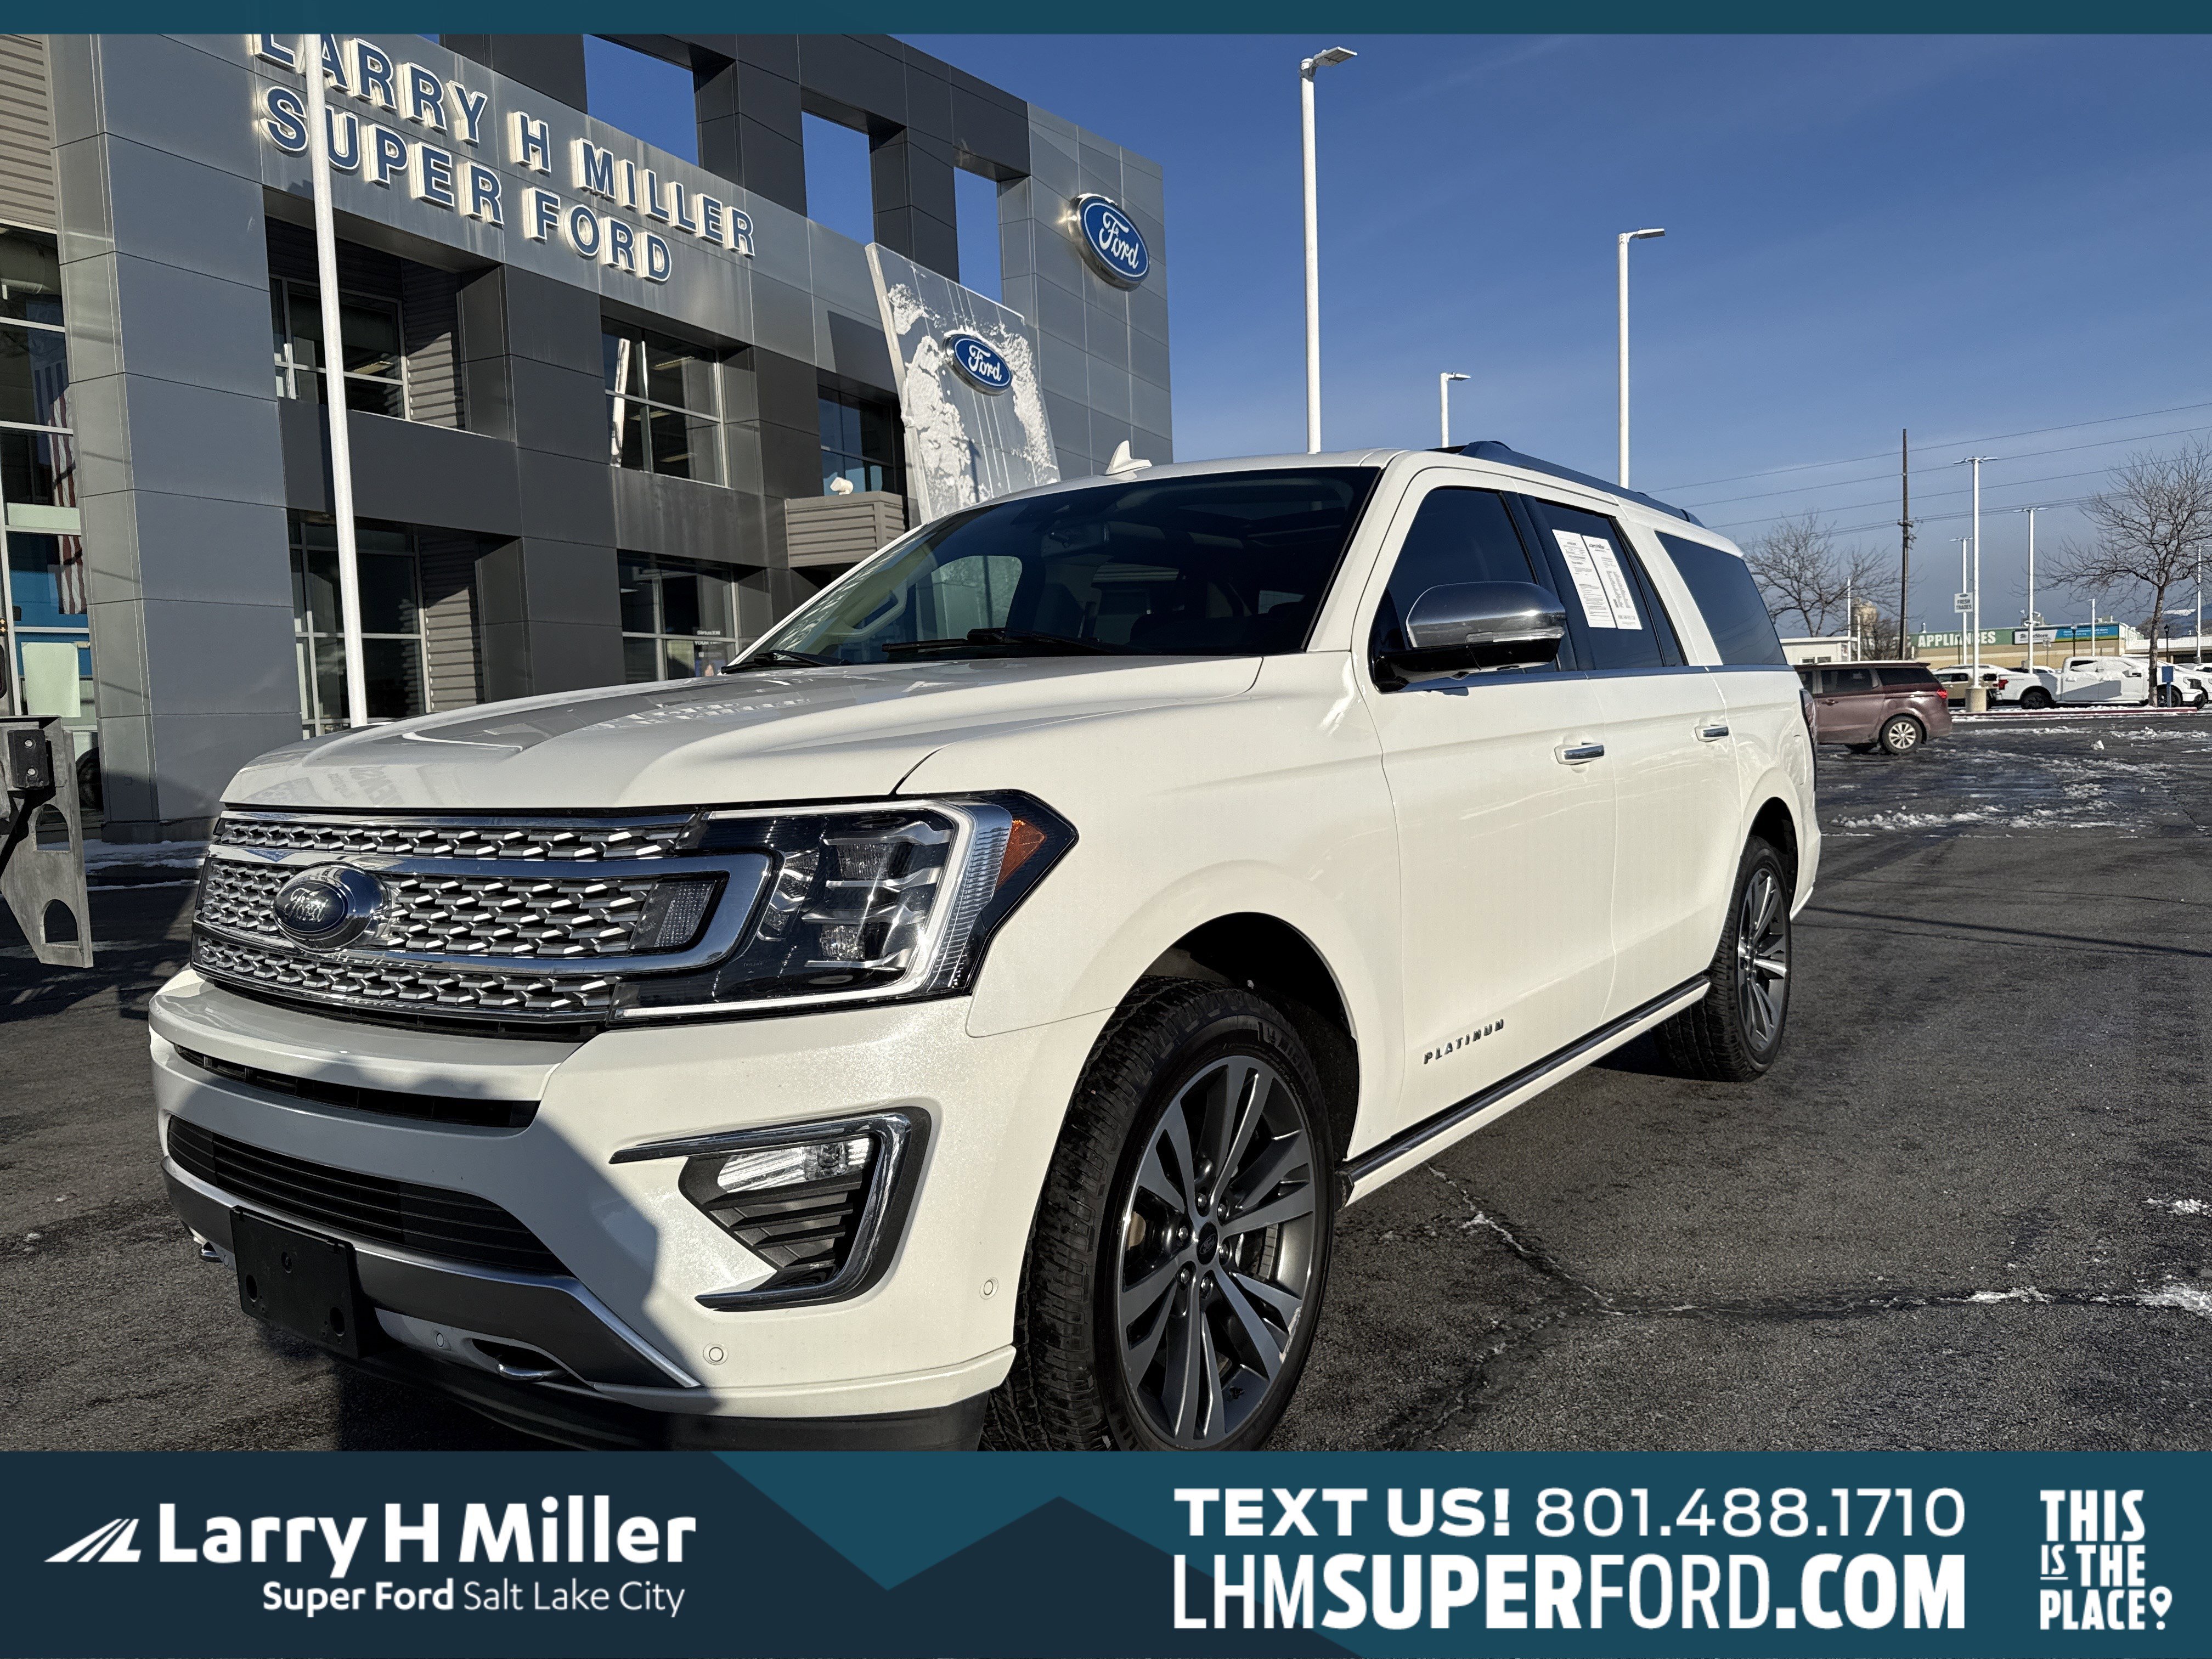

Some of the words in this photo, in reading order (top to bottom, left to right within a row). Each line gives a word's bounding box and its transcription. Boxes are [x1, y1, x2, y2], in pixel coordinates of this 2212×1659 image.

[260, 86, 504, 225] SUPER
[527, 187, 672, 282] FORD
[514, 111, 551, 173] H
[572, 138, 755, 257] MILLER
[1098, 211, 1140, 269] Ford
[968, 345, 1002, 382] Ford
[284, 887, 329, 922] Ford
[1423, 1018, 1504, 1065] PLATINUM
